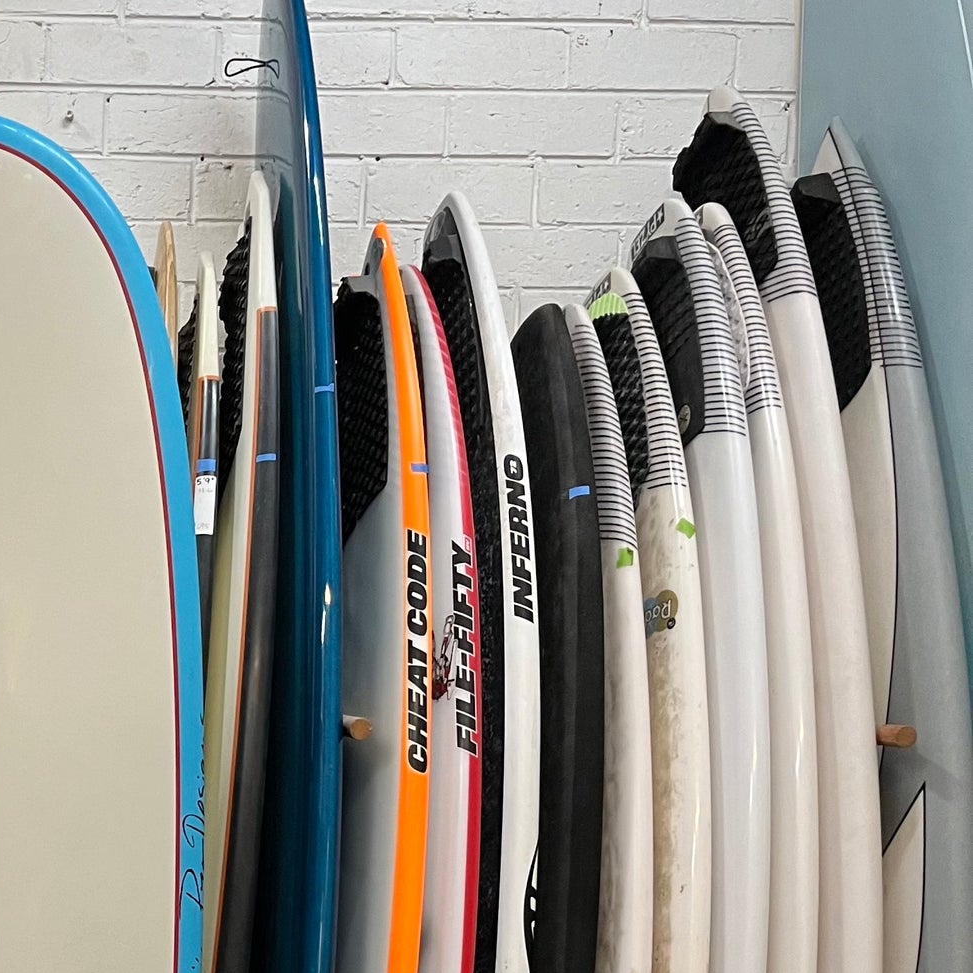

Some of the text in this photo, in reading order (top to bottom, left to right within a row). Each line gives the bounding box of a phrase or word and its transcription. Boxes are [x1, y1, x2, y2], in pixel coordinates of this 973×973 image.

[503, 454, 535, 624] INFERNO
[407, 528, 428, 774] CHEAT CODE
[451, 540, 478, 757] FILE-FIFTY
